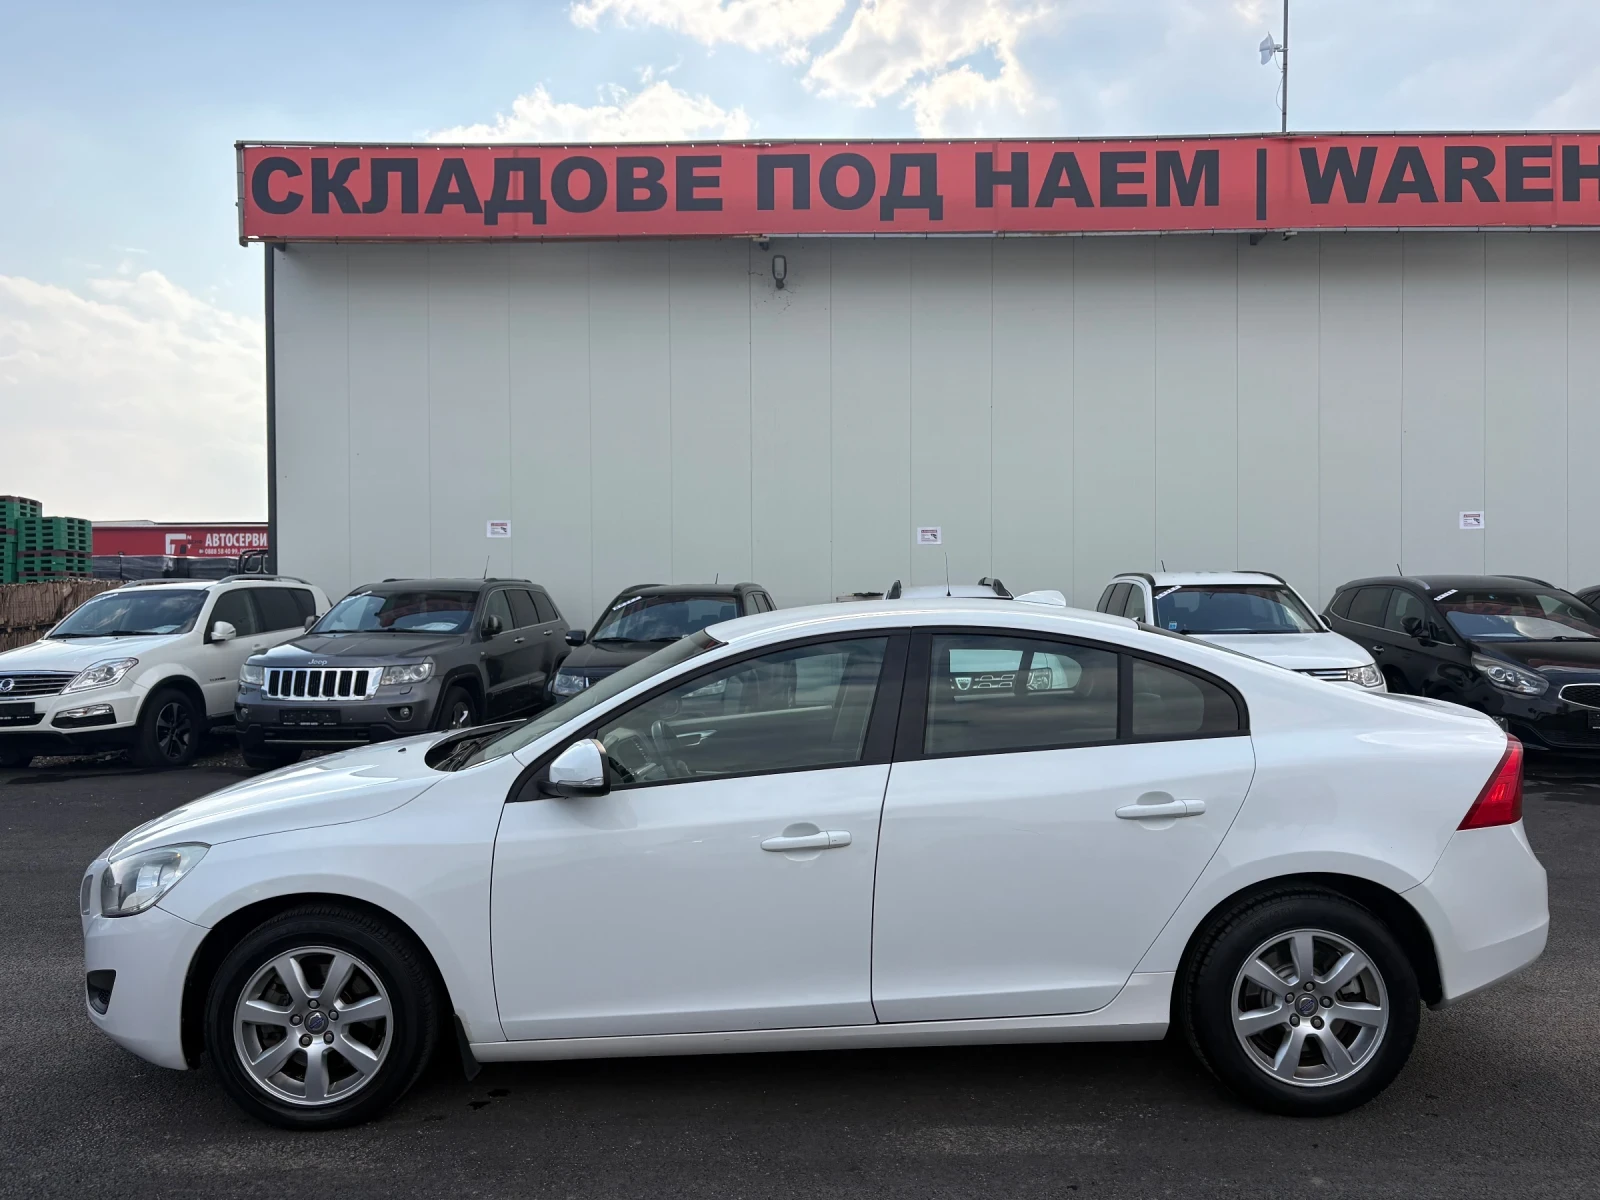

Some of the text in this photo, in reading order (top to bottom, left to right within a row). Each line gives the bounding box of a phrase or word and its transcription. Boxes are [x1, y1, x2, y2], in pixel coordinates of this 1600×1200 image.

[252, 156, 722, 225] СКЛАДОВЕ
[758, 154, 943, 221] ПОД
[976, 150, 1219, 207] НАЕМ
[1301, 146, 1600, 203] WAREH
[308, 658, 328, 666] Jeep
